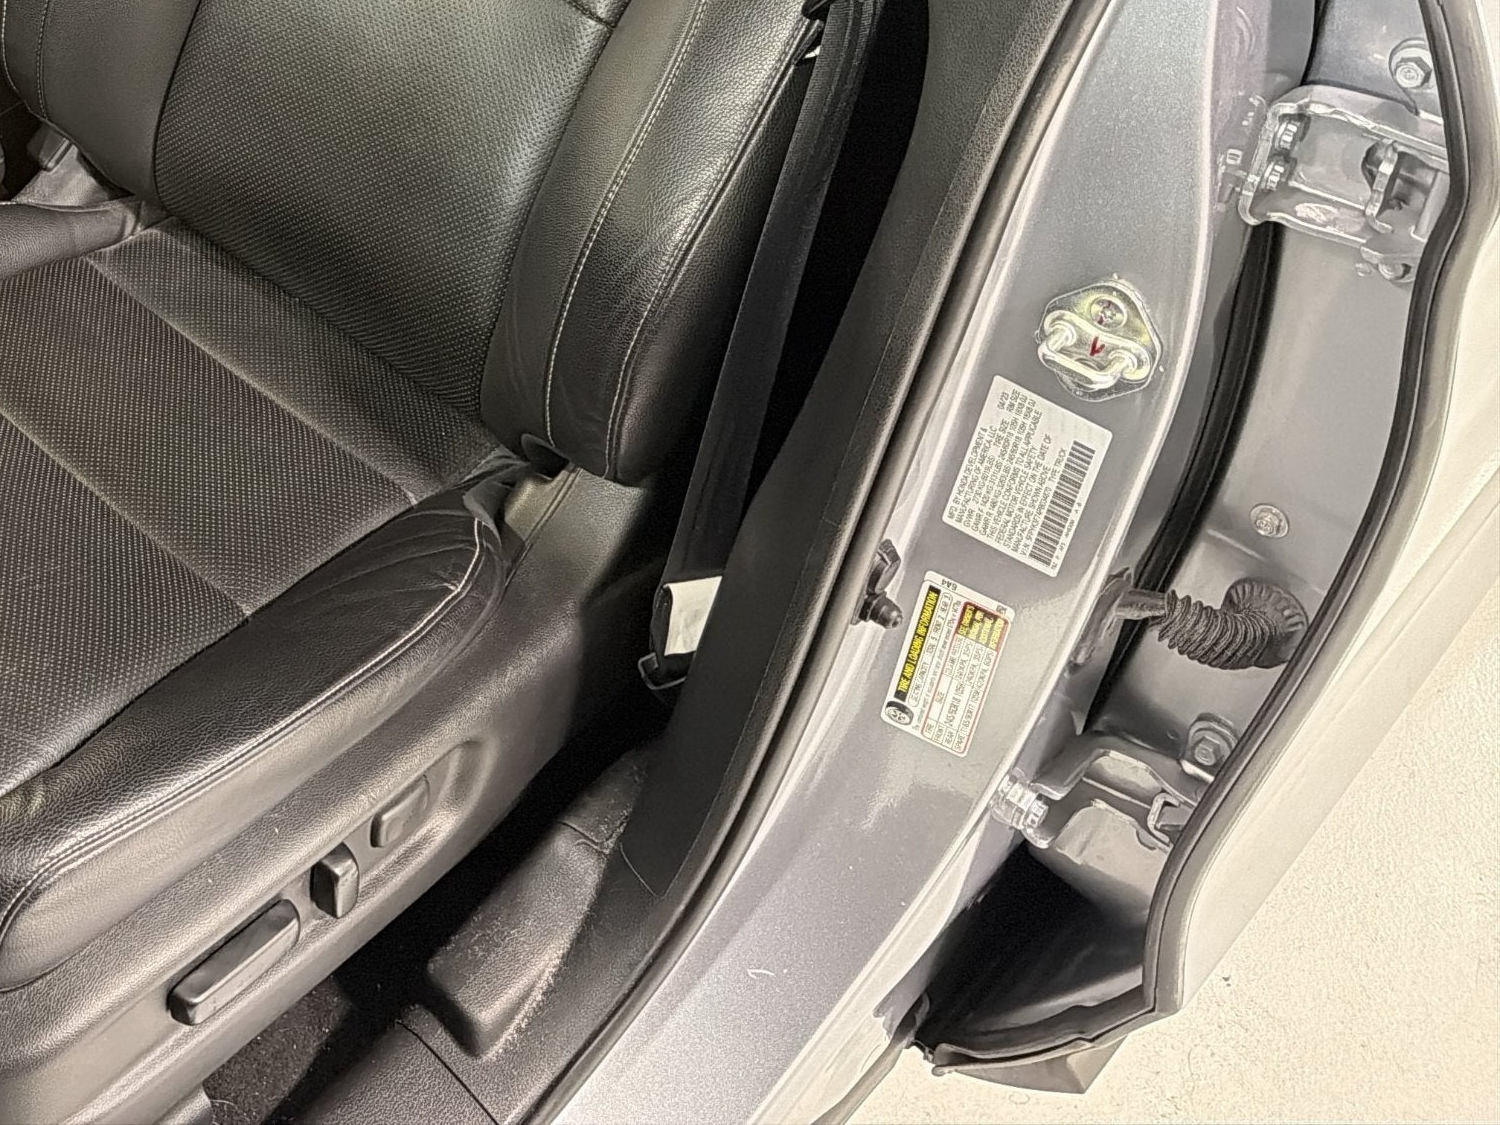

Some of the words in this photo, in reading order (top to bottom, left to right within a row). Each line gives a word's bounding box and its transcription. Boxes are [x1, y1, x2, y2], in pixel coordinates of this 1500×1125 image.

[1009, 388, 1021, 403] SIZE
[997, 417, 1010, 434] SIZE
[1021, 408, 1042, 447] APPLICABLE
[992, 432, 1004, 448] TIRE
[1017, 444, 1029, 458] ALL
[1036, 442, 1049, 461] DATE
[1053, 446, 1067, 468] TRUCK
[955, 473, 969, 496] HONDA
[963, 430, 985, 475] DEVELOPMENT
[1031, 459, 1043, 473] THE
[954, 473, 979, 524] MANUFACTURING
[986, 424, 997, 439] LLC
[1001, 465, 1021, 501] CONFORMS
[994, 515, 1011, 545] FEDERAL
[1004, 493, 1019, 518] MOTOR
[1012, 468, 1029, 496] VEHICLE
[1022, 444, 1038, 471] SAFETY
[1018, 481, 1034, 507] EFFECT
[962, 507, 976, 528] GVWR
[970, 511, 983, 532] GAWR
[991, 499, 1008, 526] VEHICLE
[1010, 507, 1033, 553] MANUFACTURE
[1027, 484, 1043, 510] SHOWN
[978, 515, 991, 536] GAWR
[986, 524, 998, 540] THIS
[1002, 512, 1022, 549] STANDARDS
[914, 589, 938, 637] INFORMATION
[905, 633, 924, 665] LOADING
[901, 661, 915, 679] AND
[896, 675, 911, 693] TIRE
[934, 690, 945, 704] SIZE
